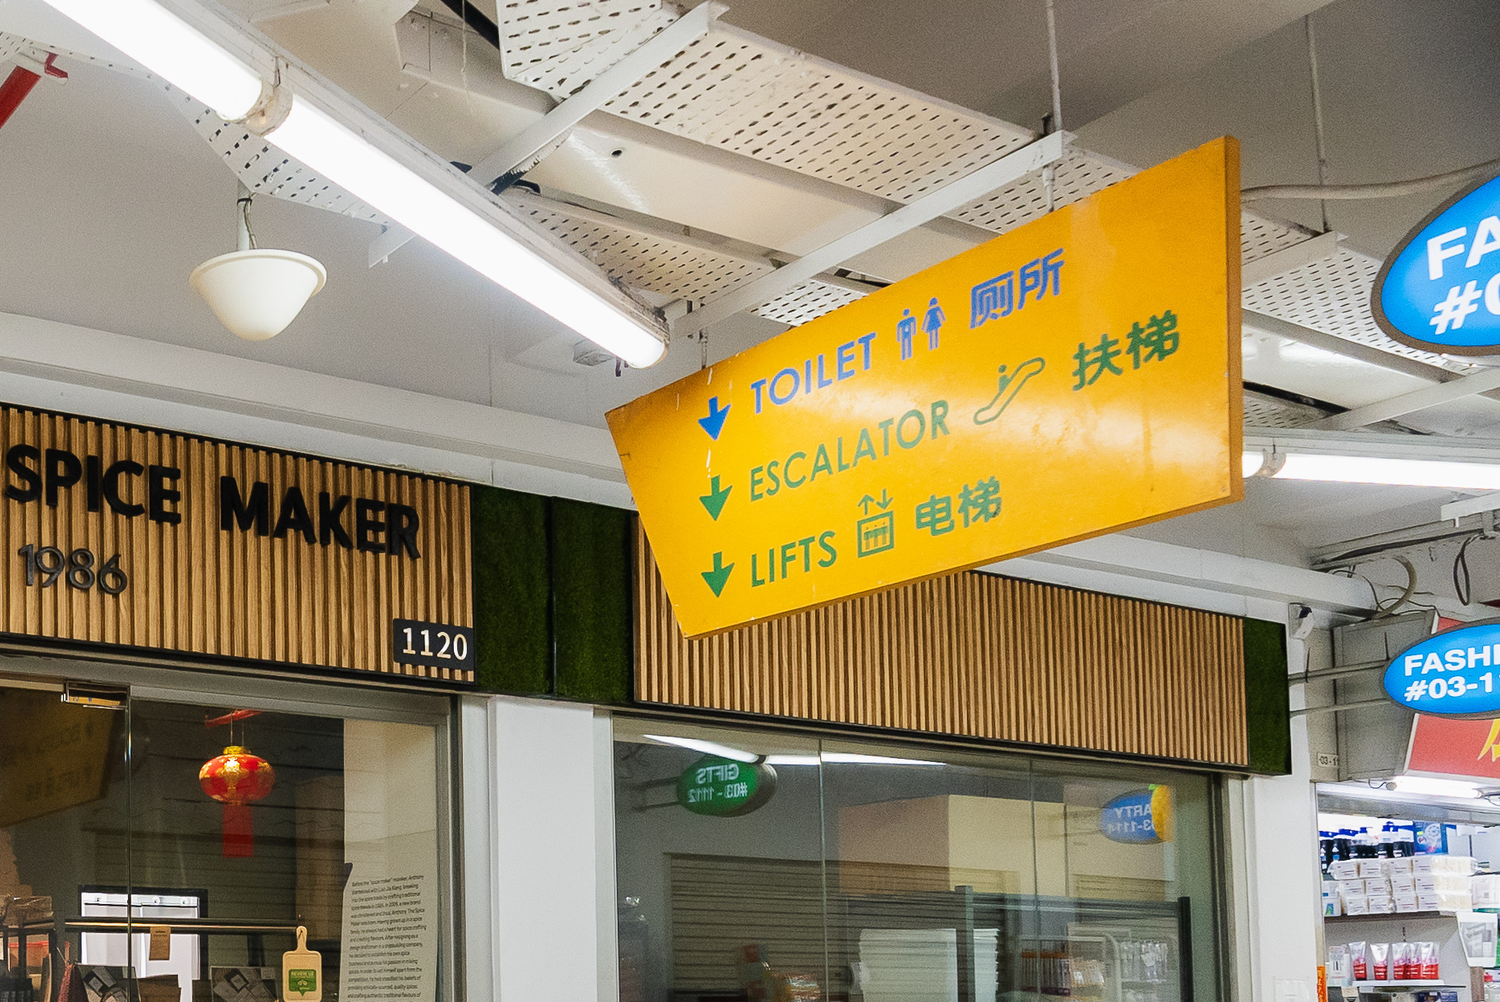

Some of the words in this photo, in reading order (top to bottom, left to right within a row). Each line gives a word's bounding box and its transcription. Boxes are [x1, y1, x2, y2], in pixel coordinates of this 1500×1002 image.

[969, 247, 1065, 331] 厕所
[750, 332, 877, 415] TOILET
[1071, 309, 1181, 392] 扶梯
[749, 400, 950, 503] ESCALATOR
[5, 444, 182, 524] SPICE
[220, 475, 421, 560] MAKER
[914, 475, 1002, 538] 电梯
[18, 543, 128, 596] 1986
[750, 532, 838, 588] LIFTS
[402, 626, 468, 661] 1120
[1404, 643, 1500, 677] FASHI
[1403, 671, 1500, 702] #03-1
